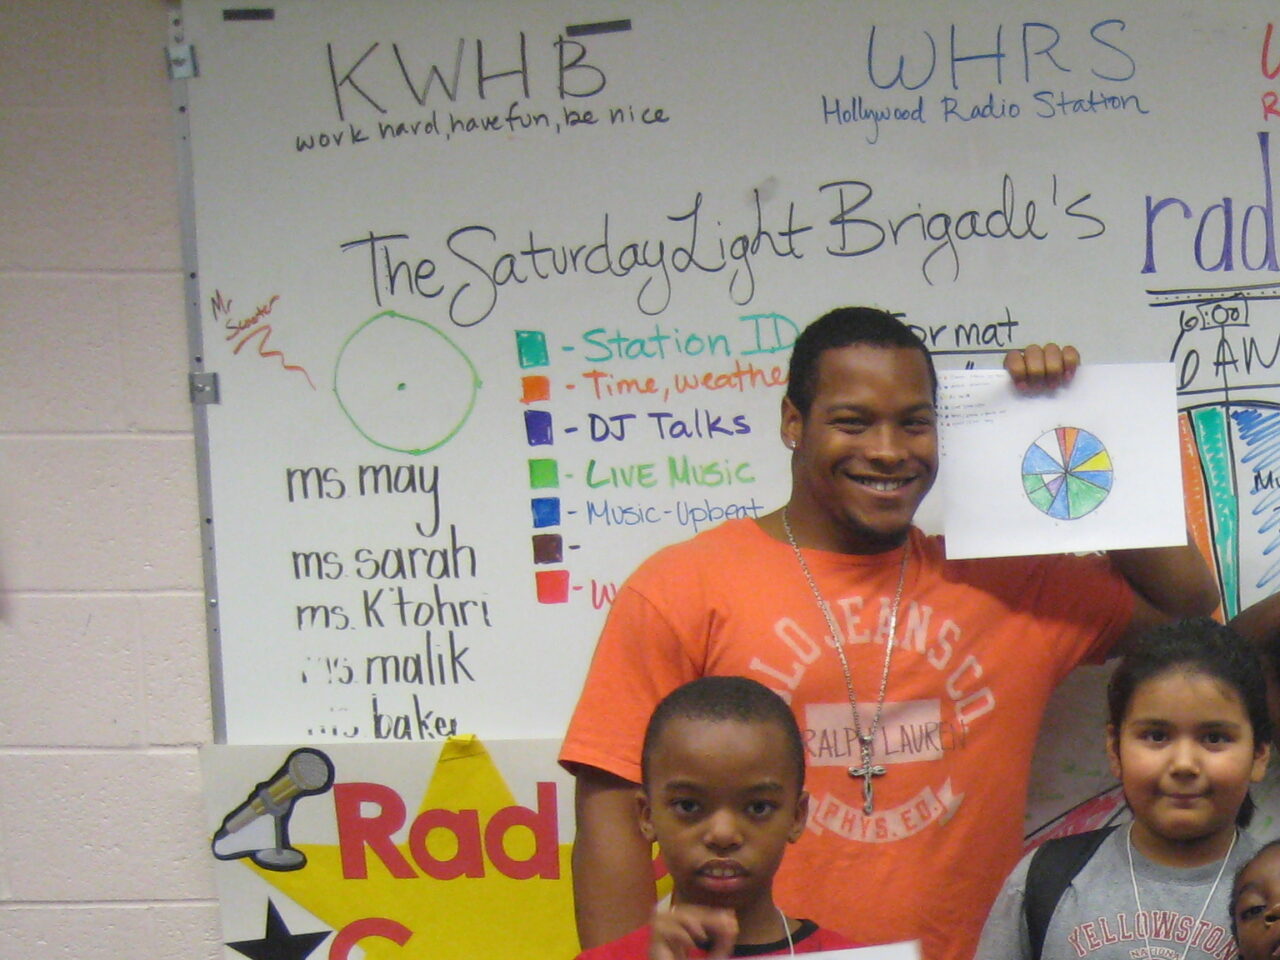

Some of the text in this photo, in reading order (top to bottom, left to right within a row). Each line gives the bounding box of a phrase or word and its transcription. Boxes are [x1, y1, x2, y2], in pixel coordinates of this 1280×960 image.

[327, 32, 606, 120] KWHB
[867, 20, 1136, 90] WHRS
[295, 127, 369, 153] work
[609, 104, 671, 125] nice
[822, 91, 1150, 145] Hollywood Radio Station
[341, 231, 445, 308] The
[447, 212, 672, 327] Saturday
[667, 190, 817, 307] Light
[818, 173, 1107, 287] Brigade's
[582, 312, 804, 362] Station ID
[588, 408, 752, 442] DJ Talks
[357, 463, 441, 538] may
[354, 523, 477, 581] sarah
[365, 630, 476, 687] malik
[824, 596, 961, 671] JEANS
